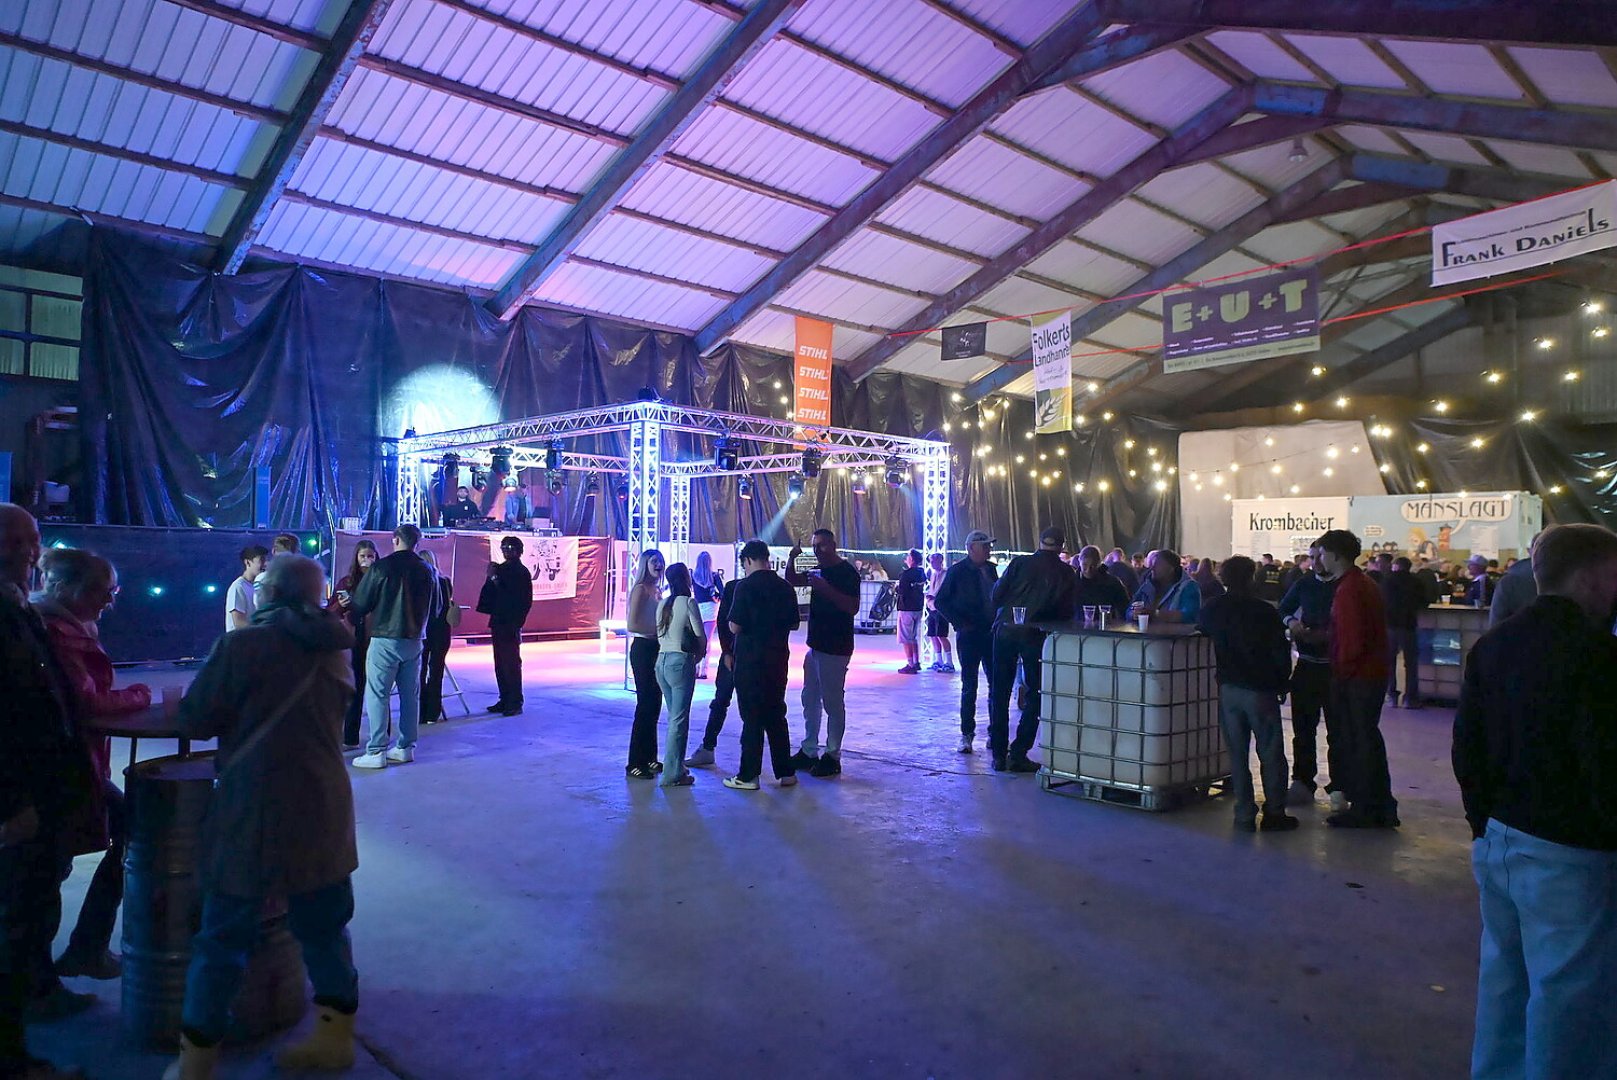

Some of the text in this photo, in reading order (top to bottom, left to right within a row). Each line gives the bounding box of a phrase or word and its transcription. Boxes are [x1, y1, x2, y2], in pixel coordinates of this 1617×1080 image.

[799, 345, 828, 360] STIHL
[799, 365, 828, 380] STIHL
[799, 387, 828, 401] STIHL
[797, 407, 826, 420] STIHL
[1249, 512, 1335, 531] Krombacher
